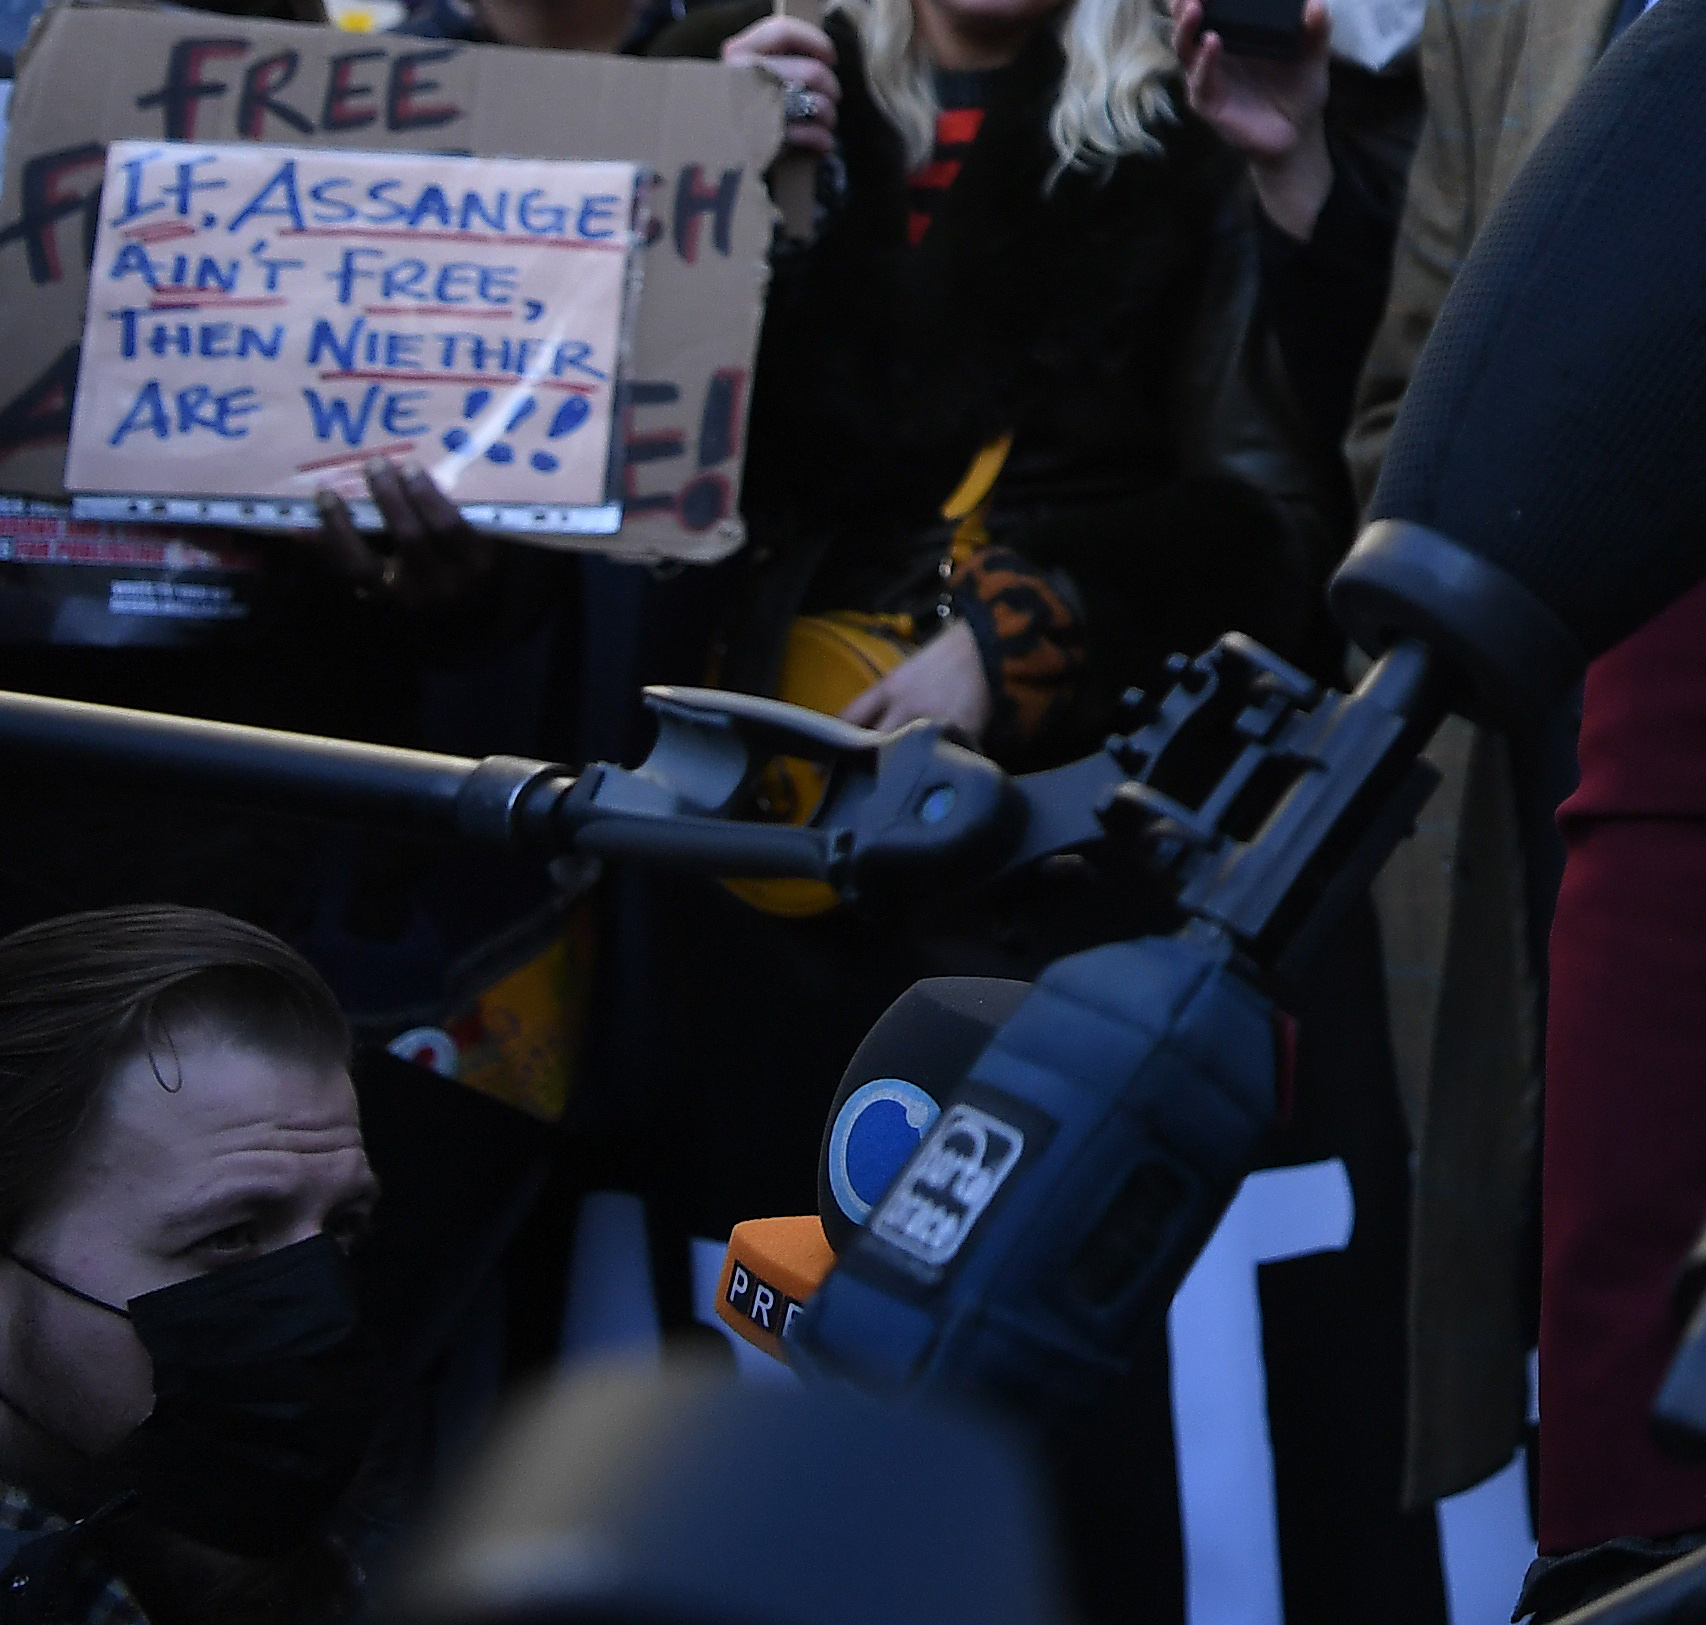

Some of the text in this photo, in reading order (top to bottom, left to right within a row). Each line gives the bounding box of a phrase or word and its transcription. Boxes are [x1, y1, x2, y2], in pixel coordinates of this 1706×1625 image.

[136, 37, 463, 142] FREE
[228, 160, 622, 240] ASSANGE
[107, 239, 546, 323] AIN'T FREE,
[107, 303, 608, 380] THEN NIETHER
[107, 378, 261, 447] ARE
